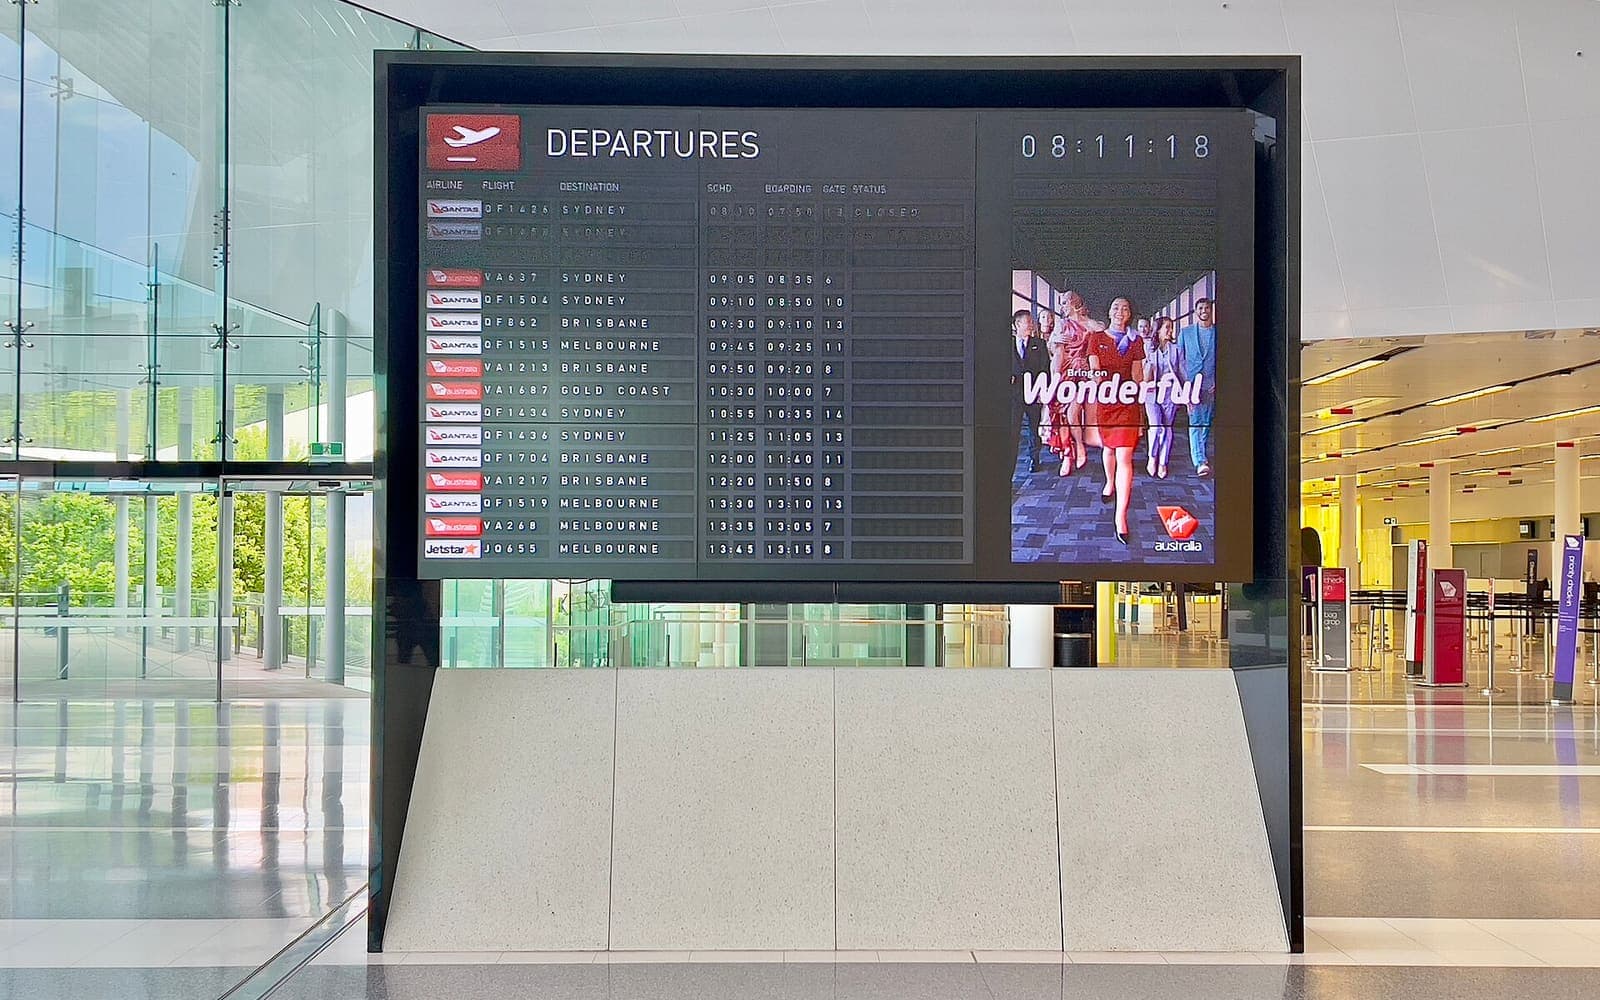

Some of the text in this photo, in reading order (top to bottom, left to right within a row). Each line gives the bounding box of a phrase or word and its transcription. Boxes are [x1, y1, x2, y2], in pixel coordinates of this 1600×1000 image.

[547, 129, 760, 158] DEPARTURES
[1022, 134, 1209, 158] 08:11:18
[426, 181, 887, 194] AIRLINE FLIGHT DESTINATION SCHD BOARDING GATE STATUS
[441, 206, 479, 214] QANTAS
[562, 206, 626, 214] SYDNEY
[484, 272, 537, 282] VA637
[562, 273, 625, 283] SYDNEY
[710, 274, 754, 284] 09:05
[484, 295, 548, 304] QF1504
[561, 295, 625, 305] SYDNEY
[710, 297, 754, 306] 09:10
[767, 297, 812, 307] 08:50
[827, 297, 843, 307] 10
[441, 317, 843, 329] QANTAS QF862 BRISBANE 09:30 09:10 13
[440, 340, 841, 352] QANTAS QF1515 MELBOURNE 09:45 09:25 11
[484, 363, 548, 372] VA1213
[561, 363, 648, 373] BRISBANE
[710, 364, 754, 374] 09:50
[767, 364, 812, 374] 09:20
[825, 365, 831, 374] 8
[1068, 369, 1093, 378] Bring
[484, 385, 548, 395] VA1687
[561, 386, 603, 395] GOLD
[617, 386, 669, 395] COAST
[710, 387, 754, 396] 10:30
[768, 387, 812, 396] 10:00
[825, 387, 831, 395] 7
[1023, 372, 1202, 405] Wonderful
[440, 407, 842, 419] QANTAS QF1434 SYDNEY 10:55 10:35 14
[484, 430, 548, 440] QF1436
[561, 431, 625, 441] SYDNEY
[710, 432, 754, 441] 11:25
[768, 432, 812, 442] 11:05
[826, 432, 842, 442] 13
[440, 453, 841, 464] QANTAS QF1704 BRISBANE 12:00 11:40 11
[483, 476, 548, 485] VA1217
[561, 476, 647, 486] BRISBANE
[710, 476, 754, 486] 12:20
[768, 477, 812, 486] 11:50
[824, 477, 831, 487] 8
[440, 498, 842, 509] QANTAS QF1519 MELBOURNE 13:30 13:10 13
[483, 521, 536, 530] VA268
[560, 521, 658, 531] MELBOURNE
[710, 521, 754, 531] 13:35
[767, 522, 812, 531] 13:05
[824, 522, 831, 531] 7
[426, 545, 465, 554] Jetstar
[560, 544, 658, 554] MELBOURNE
[710, 544, 753, 554] 13:45
[767, 544, 811, 554] 13:15
[824, 544, 831, 554] 8
[1155, 541, 1202, 552] australia
